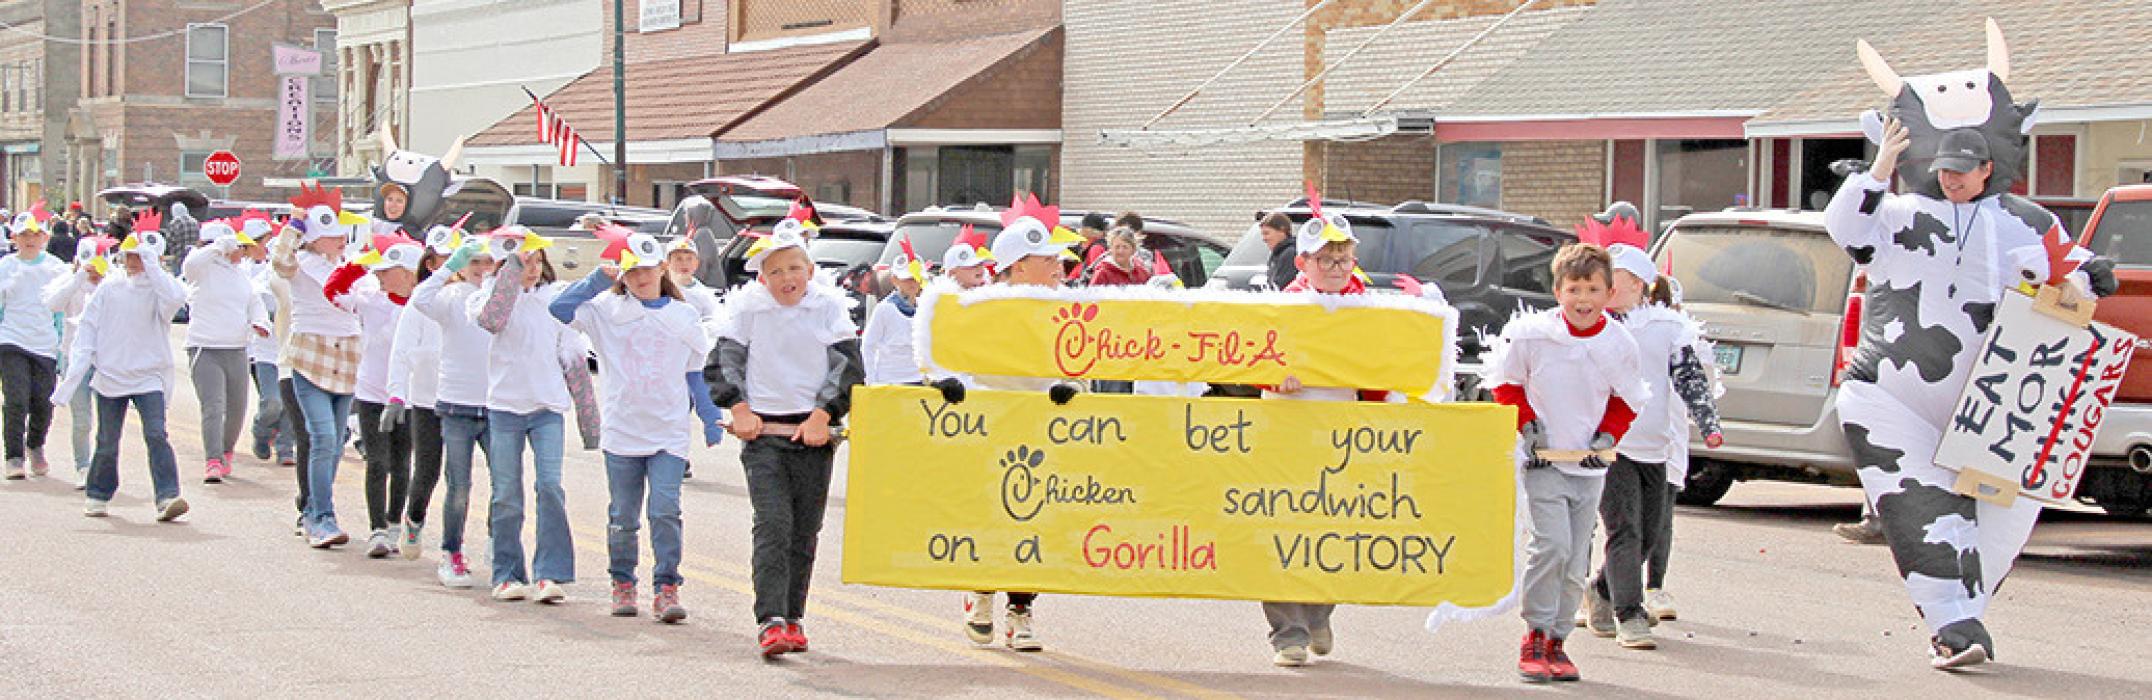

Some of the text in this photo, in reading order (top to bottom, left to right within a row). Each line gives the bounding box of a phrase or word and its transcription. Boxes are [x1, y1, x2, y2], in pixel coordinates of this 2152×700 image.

[206, 161, 238, 175] STOP
[1954, 326, 2017, 435] EAT
[1989, 337, 2070, 463] MOR
[2051, 338, 2135, 499] COUGARS
[920, 398, 1423, 474] You can bet your
[999, 445, 1422, 521] Chicken sandwich
[928, 524, 1456, 574] on a Gorilla VICTORY
